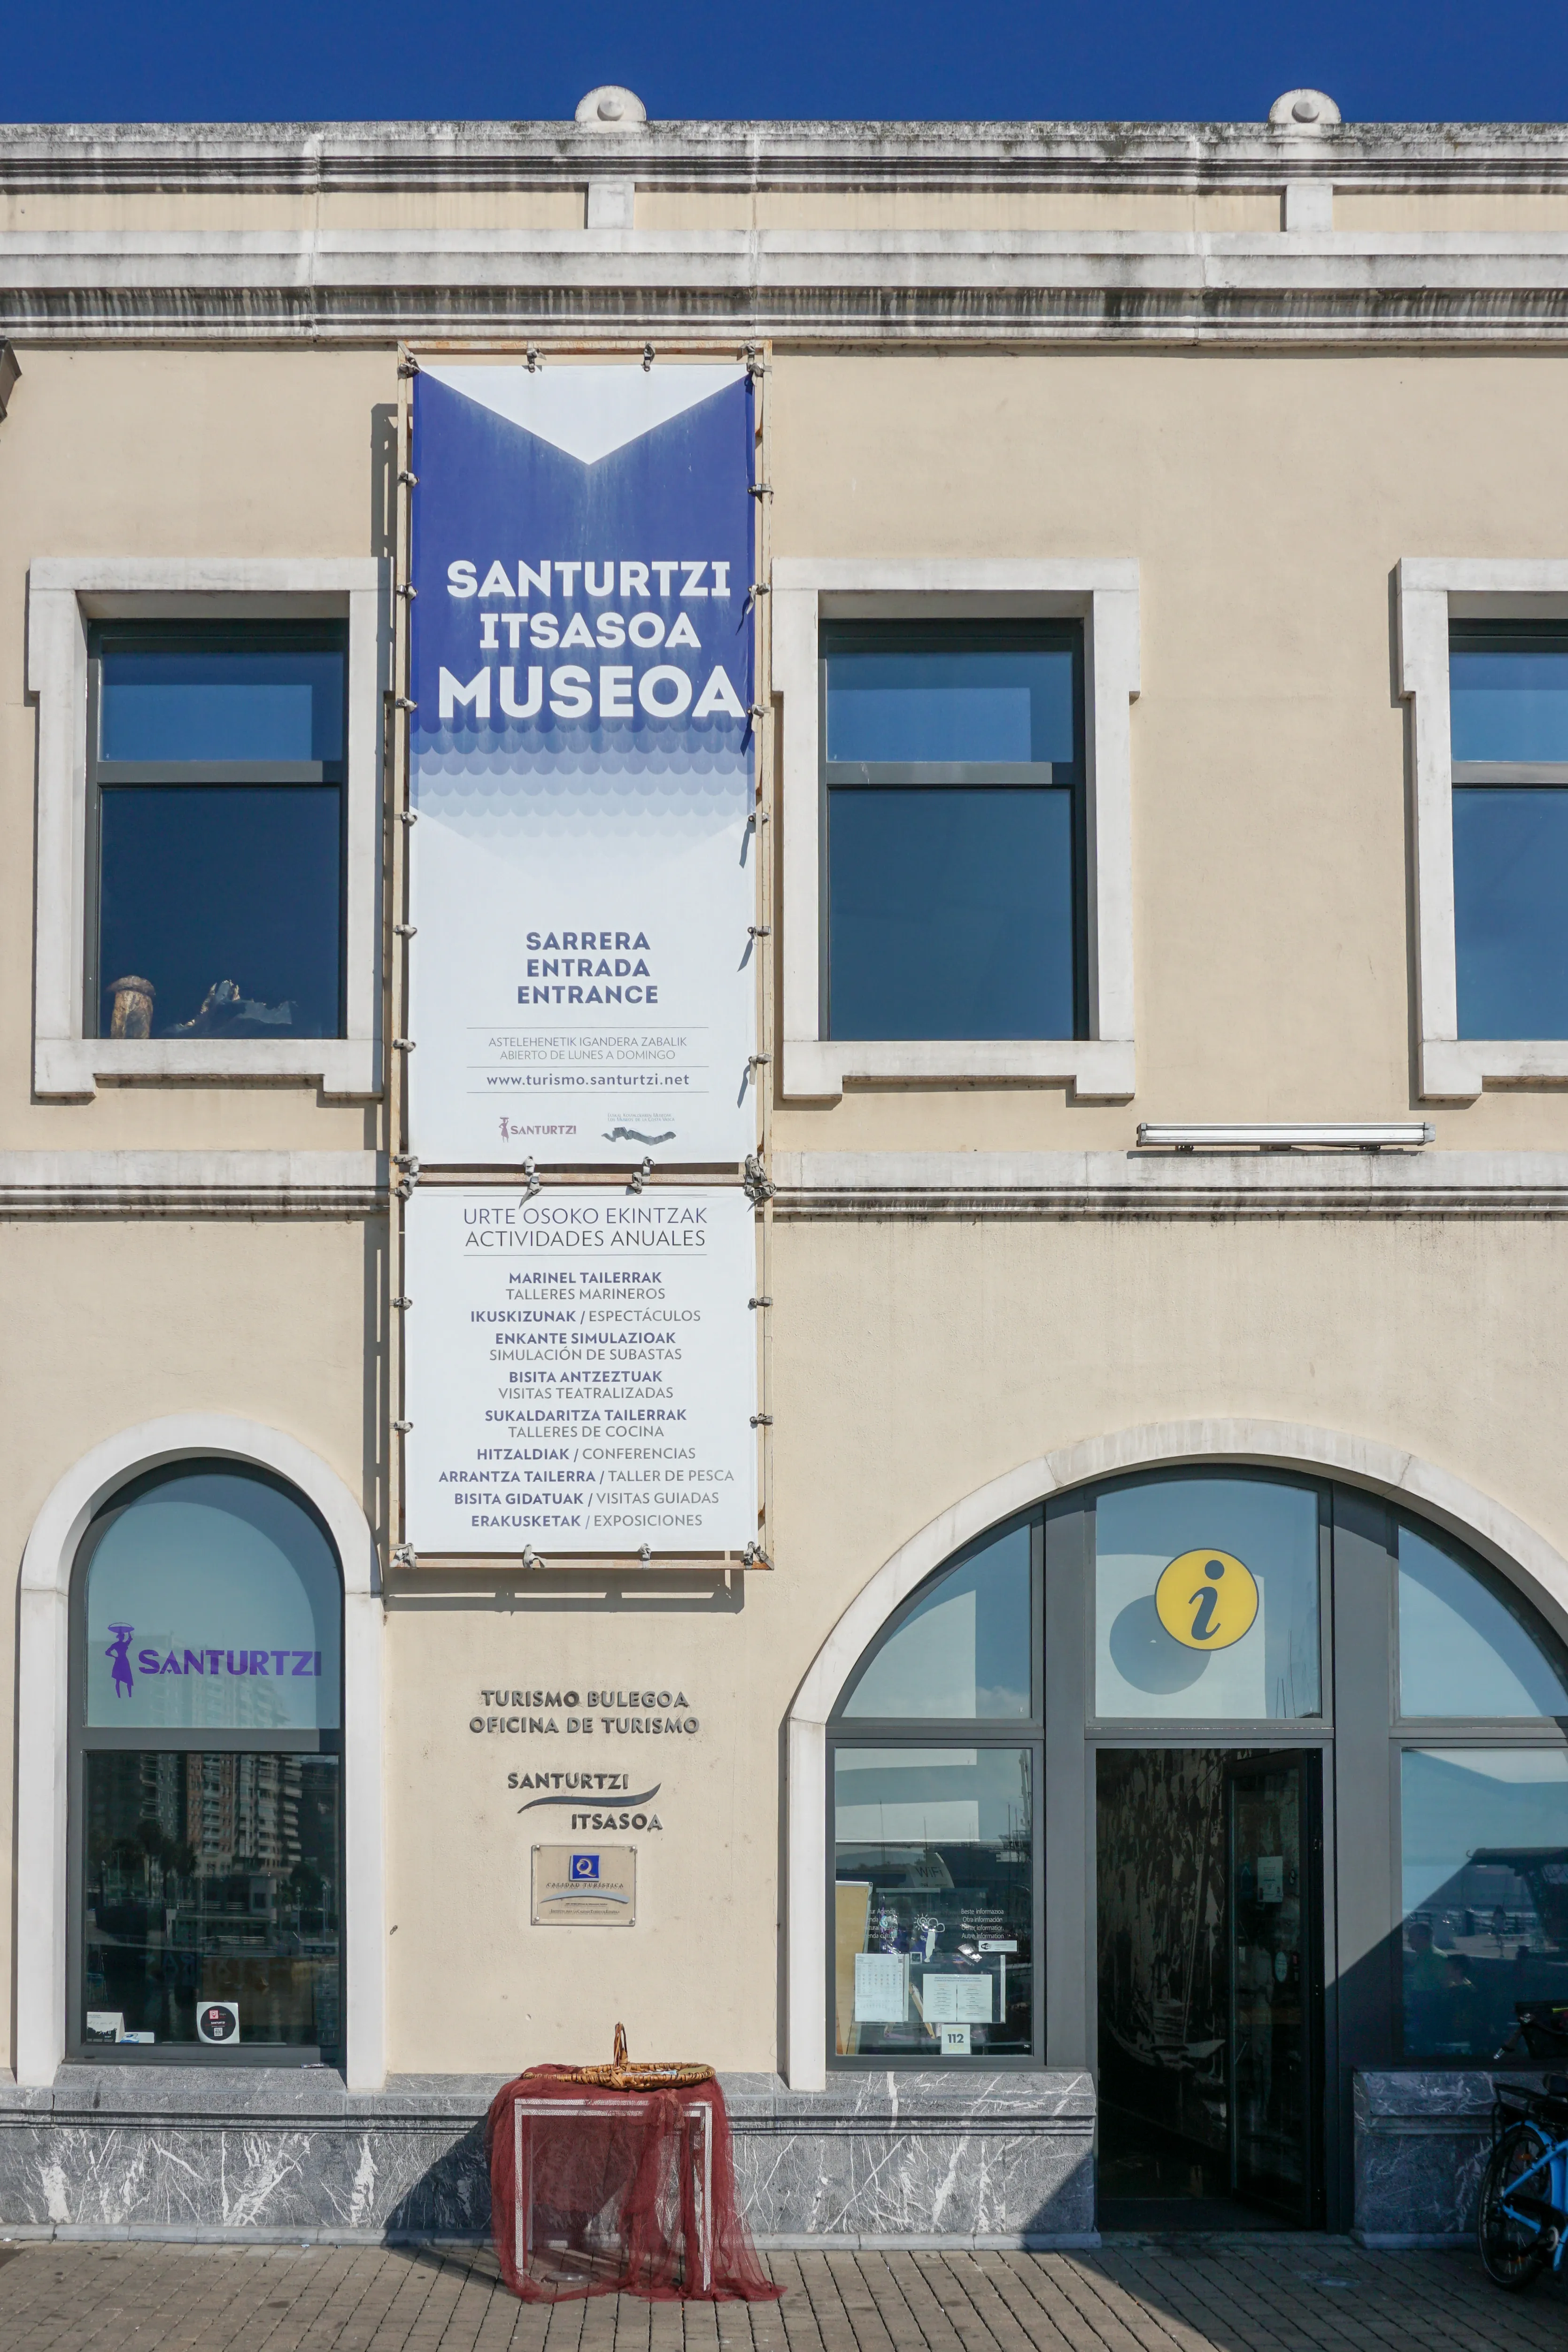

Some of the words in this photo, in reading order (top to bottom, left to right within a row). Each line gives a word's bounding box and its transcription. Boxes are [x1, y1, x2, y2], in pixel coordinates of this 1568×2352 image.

[447, 560, 730, 598] SANTURTZI
[480, 612, 701, 648] ITSASOA
[439, 665, 746, 718] MUSEOA
[526, 932, 650, 950] SARRERA
[527, 959, 650, 977] ENTRADA
[518, 986, 657, 1003] ENTRANCE
[489, 1037, 576, 1047] ASTELEHENETIK
[580, 1037, 638, 1046] IGANDERA
[641, 1037, 687, 1046] ZABALIK
[500, 1050, 547, 1060] ABIERTO
[551, 1050, 565, 1059] DE
[569, 1050, 603, 1059] LUNES
[606, 1051, 614, 1059] A
[617, 1050, 675, 1059] DOMINGO
[487, 1073, 689, 1085] www.turismo.santurtzi.net
[511, 1126, 576, 1134] SANTURTZI
[464, 1209, 515, 1224] URTE
[524, 1208, 598, 1224] OSOKO
[607, 1208, 707, 1223] EKINTZAK
[465, 1231, 603, 1246] ACTIVIDADES
[611, 1230, 704, 1246] ANUALES
[510, 1273, 576, 1283] MARINEL
[580, 1272, 661, 1283] TAILERRAK
[506, 1289, 575, 1299] TALLERES
[580, 1289, 665, 1299] MARINEROS
[471, 1311, 576, 1322] IKUSKIZUNAK
[580, 1311, 585, 1324] /
[590, 1307, 700, 1321] ESPECTÁCULOS
[496, 1333, 566, 1344] ENKANTE
[572, 1333, 675, 1343] SIMULAZIOAK
[490, 1346, 581, 1360] SIMULACIÓN
[587, 1349, 605, 1360] DE
[610, 1349, 681, 1360] SUBASTAS
[510, 1372, 556, 1382] BISITA
[560, 1371, 662, 1382] ANTZEZTUAK
[499, 1388, 551, 1399] VISITAS
[556, 1387, 673, 1398] TEATRALIZADAS
[486, 1410, 601, 1421] SUKALDARITZA
[604, 1409, 686, 1421] TAILERRAK
[508, 1426, 577, 1437] TALLERES
[582, 1426, 601, 1437] DE
[606, 1426, 664, 1437] COCINA
[478, 1449, 569, 1459] HITZALDIAK
[574, 1449, 579, 1462] /
[583, 1448, 695, 1459] CONFERENCIAS
[439, 1471, 520, 1482] ARRANTZA
[524, 1471, 595, 1482] TAILERRA
[600, 1471, 604, 1484] /
[608, 1470, 660, 1481] TALLER
[665, 1470, 683, 1481] DE
[689, 1470, 734, 1481] PESCA
[455, 1493, 501, 1504] BISITA
[506, 1493, 583, 1504] GIDATUAK
[588, 1493, 593, 1507] /
[596, 1493, 649, 1504] VISITAS
[654, 1492, 718, 1504] GUIADAS
[472, 1515, 580, 1527] ERAKUSKETAK
[585, 1515, 590, 1529] /
[595, 1515, 702, 1526] EXPOSICIONES
[139, 1649, 321, 1676] SANTURTZI
[482, 1690, 579, 1708] TURISMO
[587, 1690, 689, 1708] BULEGOA
[470, 1717, 558, 1733] OFICINA
[567, 1717, 593, 1733] DE
[602, 1717, 699, 1733] TURISMO
[508, 1773, 628, 1789] SANTURTZI
[572, 1814, 663, 1830] ITSASOA
[915, 1867, 943, 1878] WiFi
[948, 2034, 964, 2043] 112
